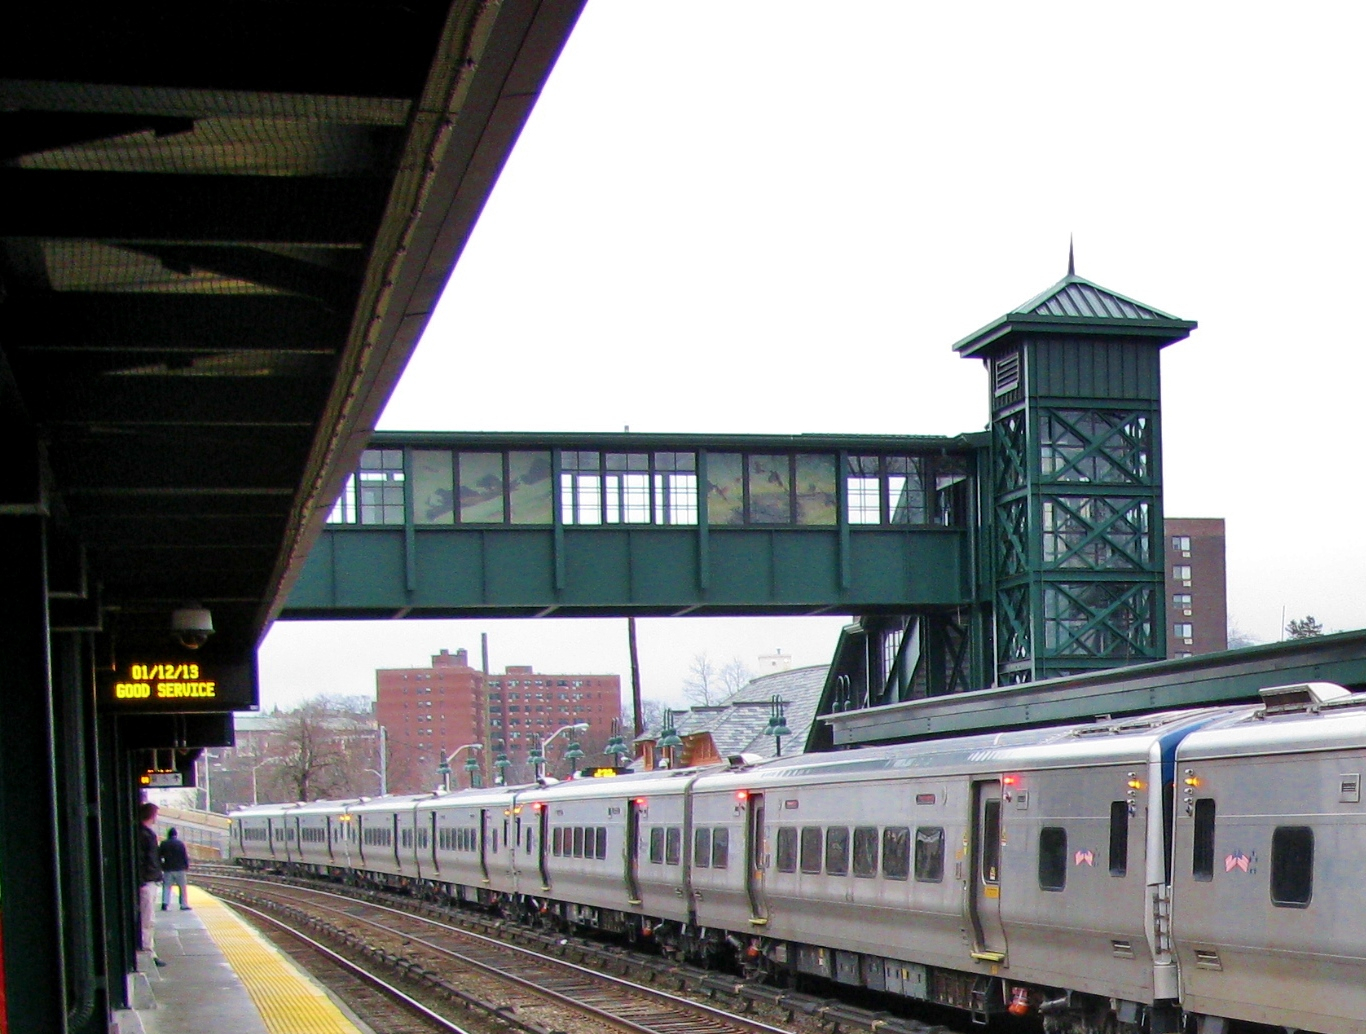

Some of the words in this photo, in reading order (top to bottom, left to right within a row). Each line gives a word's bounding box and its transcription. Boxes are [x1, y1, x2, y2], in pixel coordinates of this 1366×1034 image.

[131, 664, 199, 680] 01/12/13
[115, 683, 151, 698] GOOD
[157, 682, 216, 698] SERVICE
